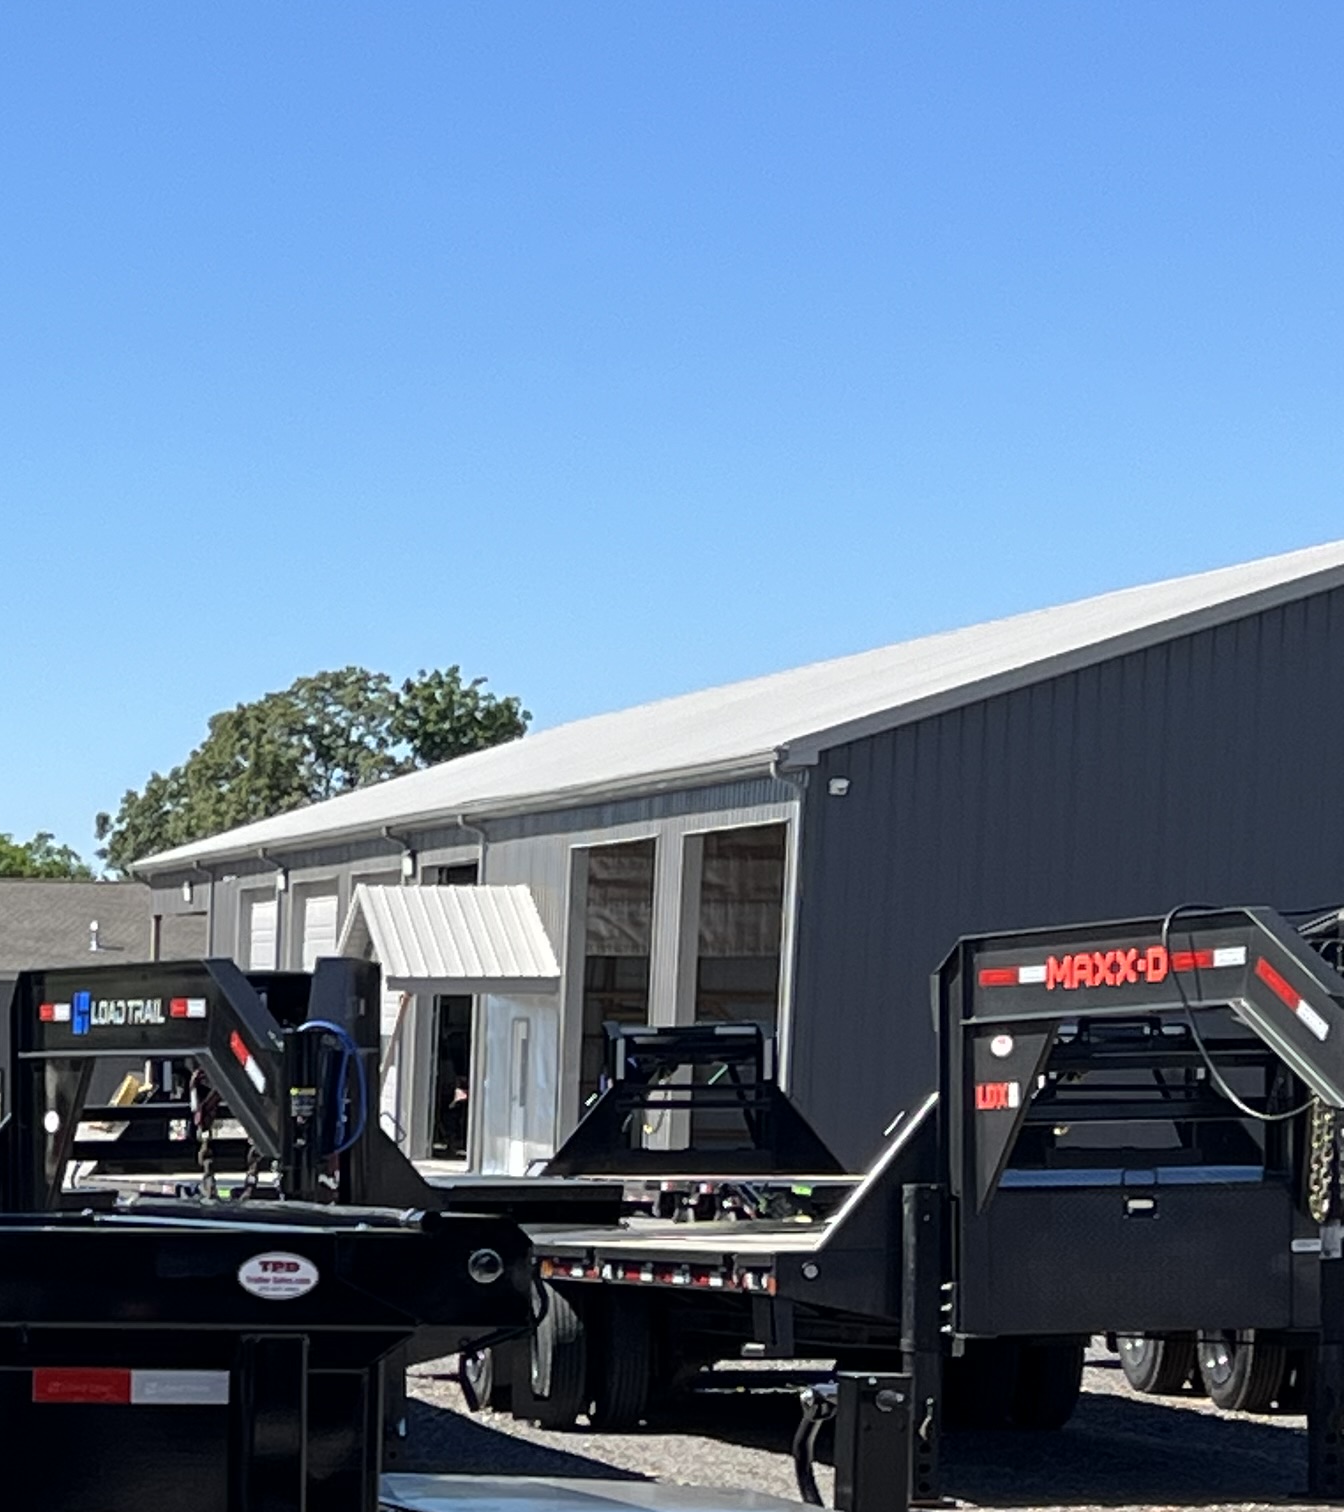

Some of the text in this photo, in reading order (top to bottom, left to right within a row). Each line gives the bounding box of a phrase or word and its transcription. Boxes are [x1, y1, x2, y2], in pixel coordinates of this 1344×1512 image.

[90, 998, 166, 1026] LOAD TRAIL
[258, 1260, 301, 1273] TPD
